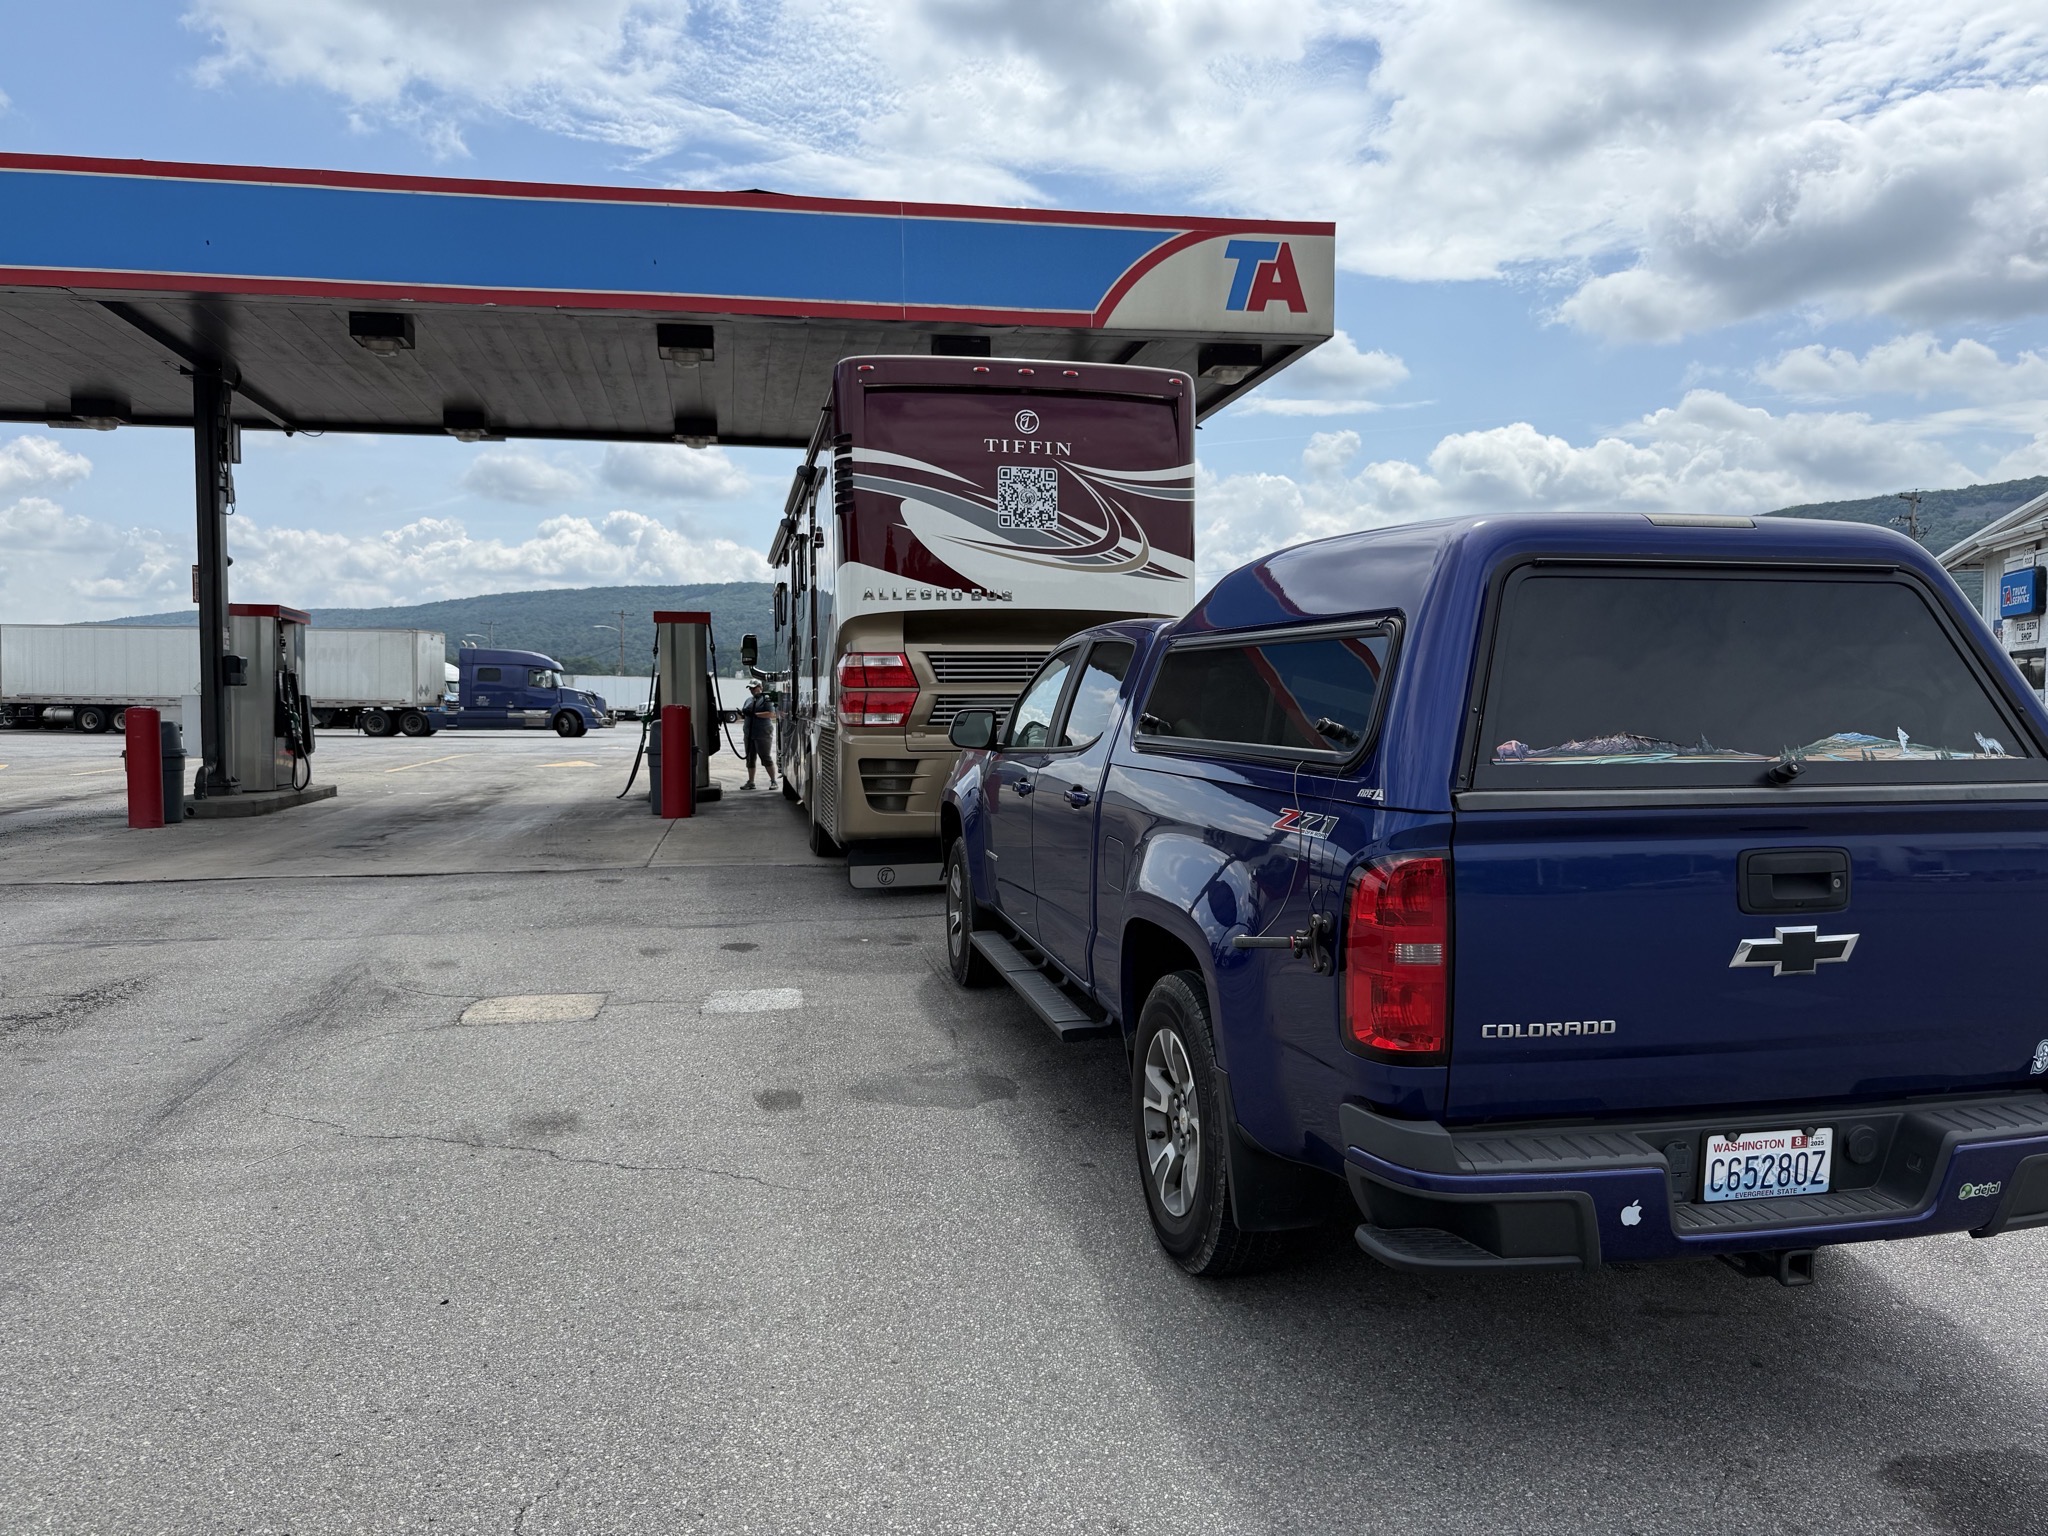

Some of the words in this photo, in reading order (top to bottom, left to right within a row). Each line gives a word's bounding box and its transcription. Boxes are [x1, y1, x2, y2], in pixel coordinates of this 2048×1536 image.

[1224, 239, 1308, 313] TA
[984, 438, 1072, 456] TIFFIN
[862, 587, 963, 601] ALLEGRO
[971, 588, 1013, 602] BUS
[2012, 585, 2027, 596] TRUCK
[2012, 594, 2030, 605] SERVICE
[2016, 622, 2025, 631] FUEL
[2026, 621, 2037, 630] DESK
[2021, 632, 2032, 641] SHOP
[1271, 808, 1339, 836] Z71
[1481, 1020, 1617, 1039] COLORADO
[1713, 1138, 1785, 1153] WASHINGTON
[1710, 1151, 1826, 1192] C65280Z
[1734, 1189, 1775, 1199] EVERGREEN
[1776, 1187, 1798, 1196] STATE
[1974, 1181, 2001, 1197] dejal
